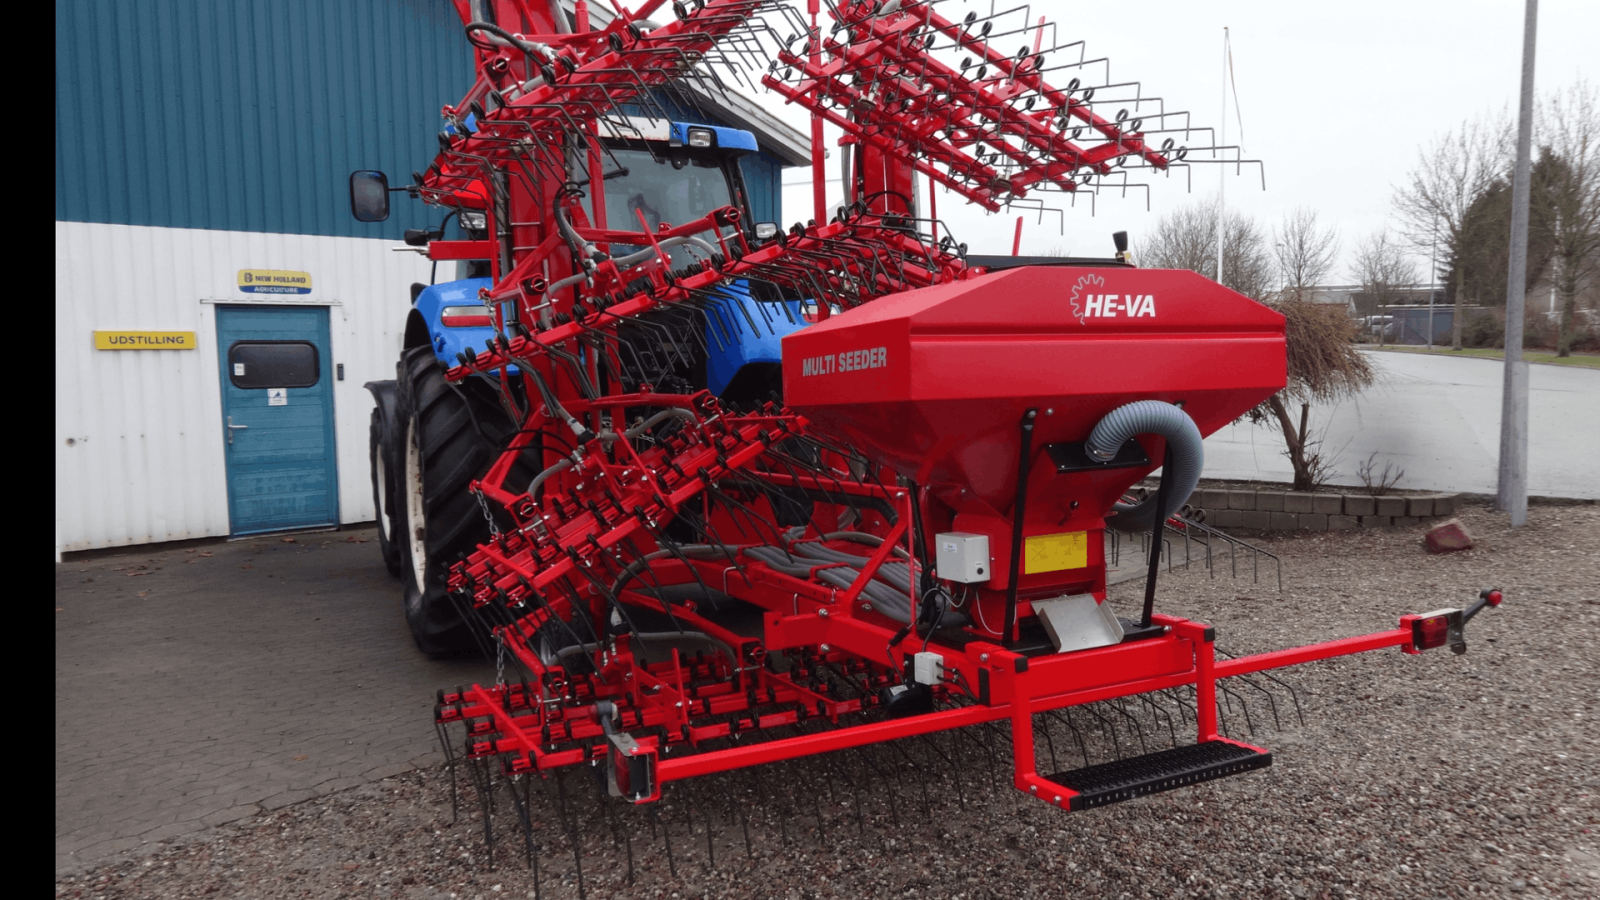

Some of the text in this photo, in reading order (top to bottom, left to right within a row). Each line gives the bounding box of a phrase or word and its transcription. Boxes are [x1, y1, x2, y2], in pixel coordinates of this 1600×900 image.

[1084, 294, 1156, 317] HE-VA
[108, 336, 185, 345] UDSTILLING
[802, 346, 887, 377] MULTI SEEDER
